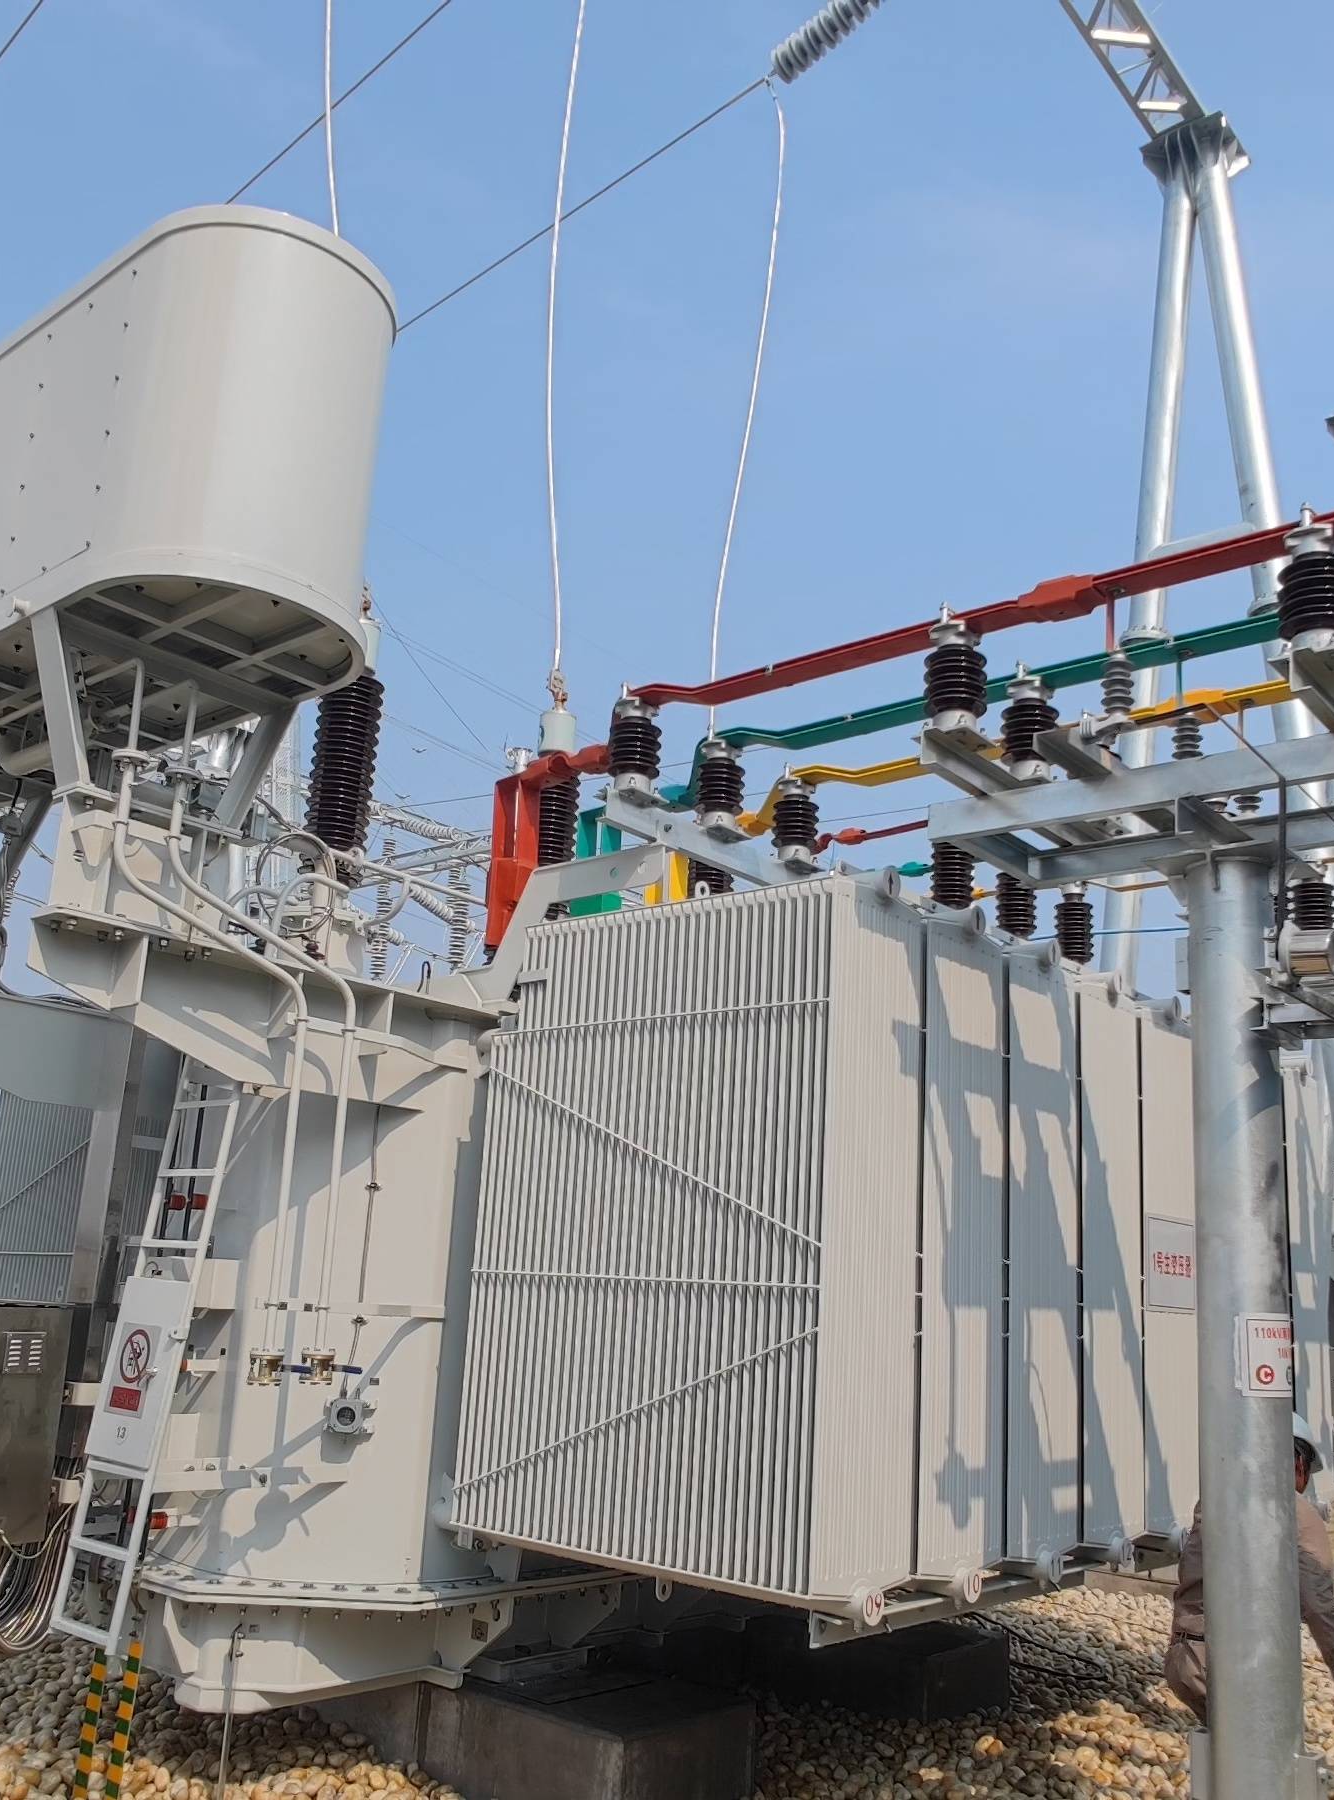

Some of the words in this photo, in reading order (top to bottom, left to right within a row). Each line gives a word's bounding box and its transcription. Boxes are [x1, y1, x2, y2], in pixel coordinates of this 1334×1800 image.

[1153, 1251, 1191, 1278] 1号主变压器
[1258, 1366, 1273, 1383] C
[967, 1574, 980, 1596] 10
[866, 1593, 882, 1618] 09
